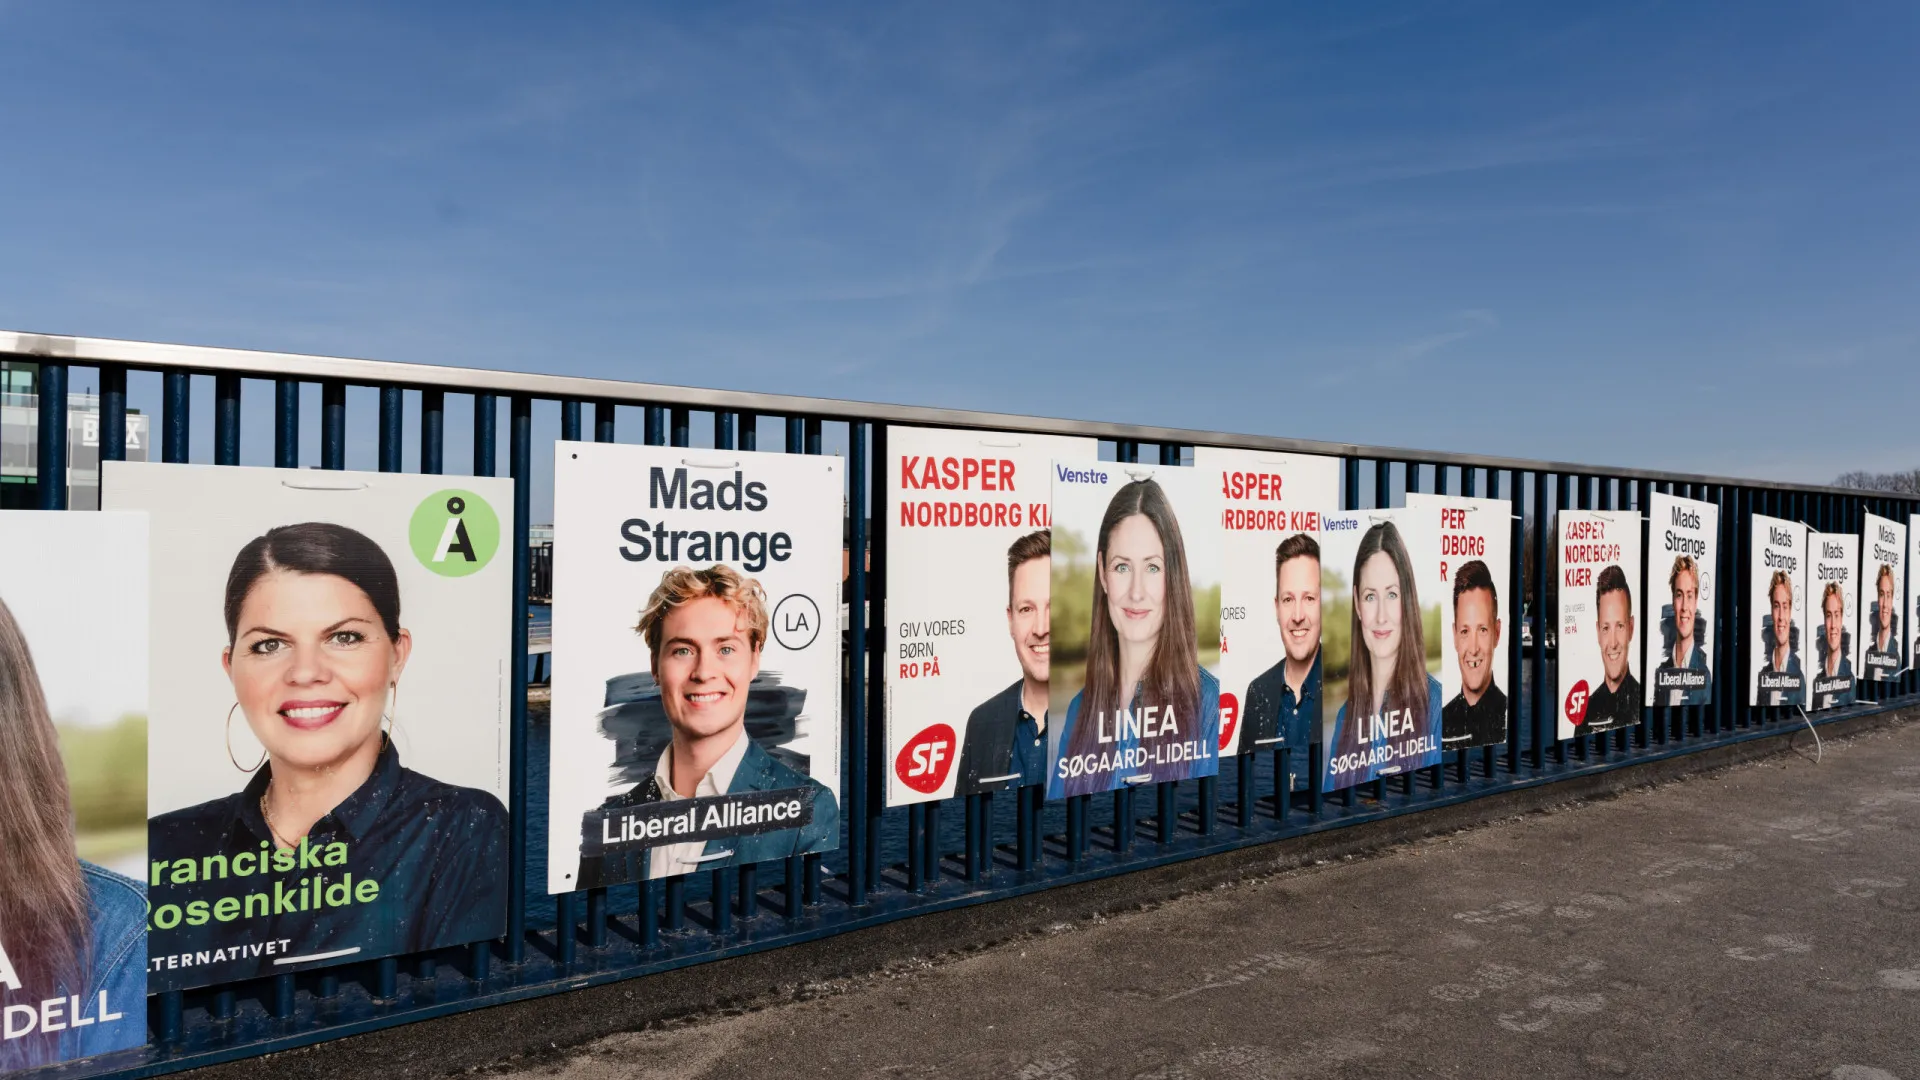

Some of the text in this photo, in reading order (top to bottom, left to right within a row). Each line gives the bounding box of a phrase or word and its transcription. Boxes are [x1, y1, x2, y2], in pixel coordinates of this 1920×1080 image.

[83, 418, 140, 444] BX
[901, 456, 1016, 491] KASPER
[1057, 464, 1108, 485] Venstre
[649, 467, 768, 511] Mads
[900, 502, 1022, 527] NORDBORG
[1222, 509, 1286, 531] RDBORG
[1323, 516, 1358, 532] Venstre
[1441, 508, 1466, 529] PER
[1671, 505, 1700, 530] Mads
[432, 496, 477, 562] Å
[1565, 521, 1605, 540] KASPER
[1769, 526, 1792, 548] Mads
[1878, 524, 1896, 545] Mads
[619, 518, 792, 573] Strange
[1440, 535, 1485, 556] DBORG
[1565, 544, 1620, 564] NORDBORG
[1665, 530, 1706, 560] Strange
[1823, 541, 1844, 559] Mads
[1873, 543, 1899, 568] Strange
[1764, 548, 1797, 574] Strange
[1565, 568, 1592, 587] KIÆR
[1818, 563, 1848, 584] Strange
[785, 611, 809, 632] LA
[899, 620, 966, 638] GIV VORES
[899, 641, 934, 659] BØRN
[899, 656, 941, 679] RO PÅ
[1659, 672, 1705, 686] Liberal Alliance
[1761, 676, 1800, 688] Liberal Alliance
[1815, 678, 1850, 693] Liberal Alliance
[1569, 690, 1585, 713] SF
[1099, 704, 1178, 743] LINEA
[1219, 707, 1233, 735] F
[1358, 708, 1414, 743] LINEA
[908, 741, 948, 777] SF
[1058, 740, 1211, 779] SØGAARD-LIDELL
[1330, 735, 1437, 773] SØGAARD-LIDELL
[602, 799, 801, 843] Liberal Alliance
[147, 873, 380, 931] osenkilde
[4, 989, 122, 1040] DELL
